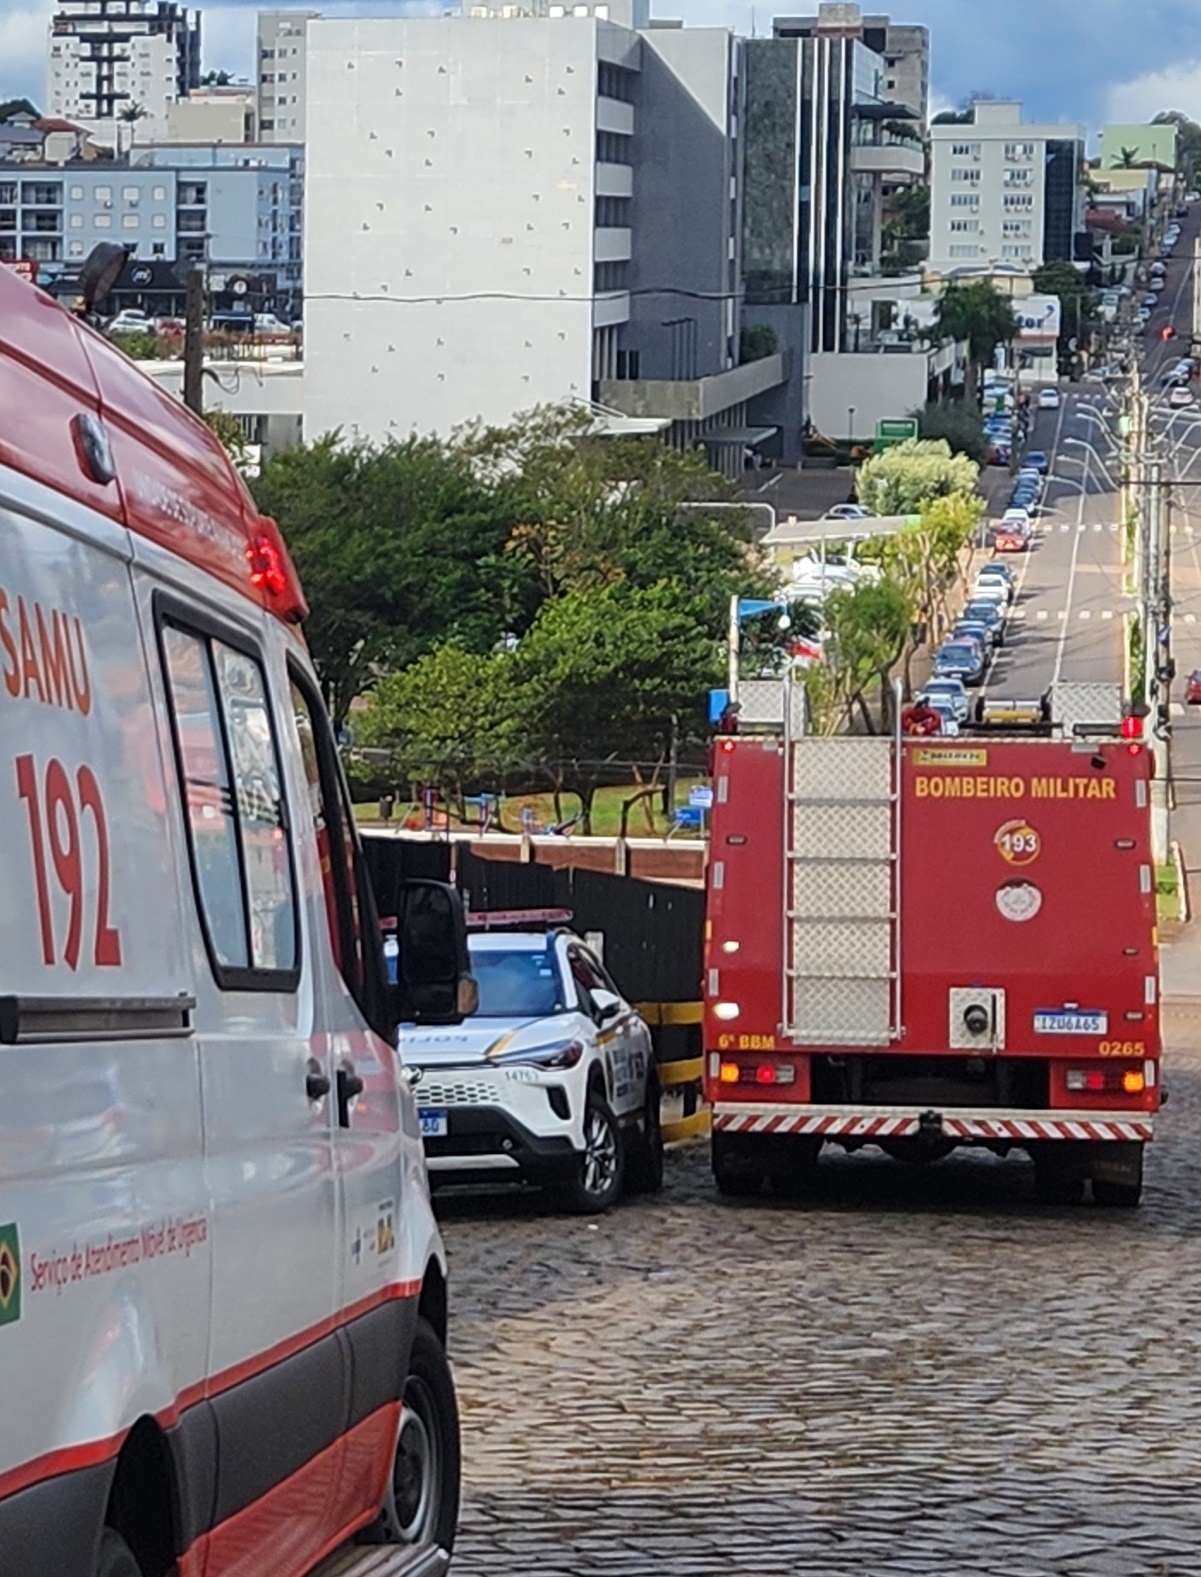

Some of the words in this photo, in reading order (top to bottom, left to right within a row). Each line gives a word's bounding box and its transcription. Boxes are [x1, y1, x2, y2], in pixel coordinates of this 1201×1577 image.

[915, 776, 1025, 797] BOMBEIRO
[1031, 777, 1115, 798] MILITAR
[1001, 833, 1037, 852] 193
[15, 754, 121, 971] 192
[1099, 1041, 1144, 1056] 0265
[71, 1240, 82, 1280] de
